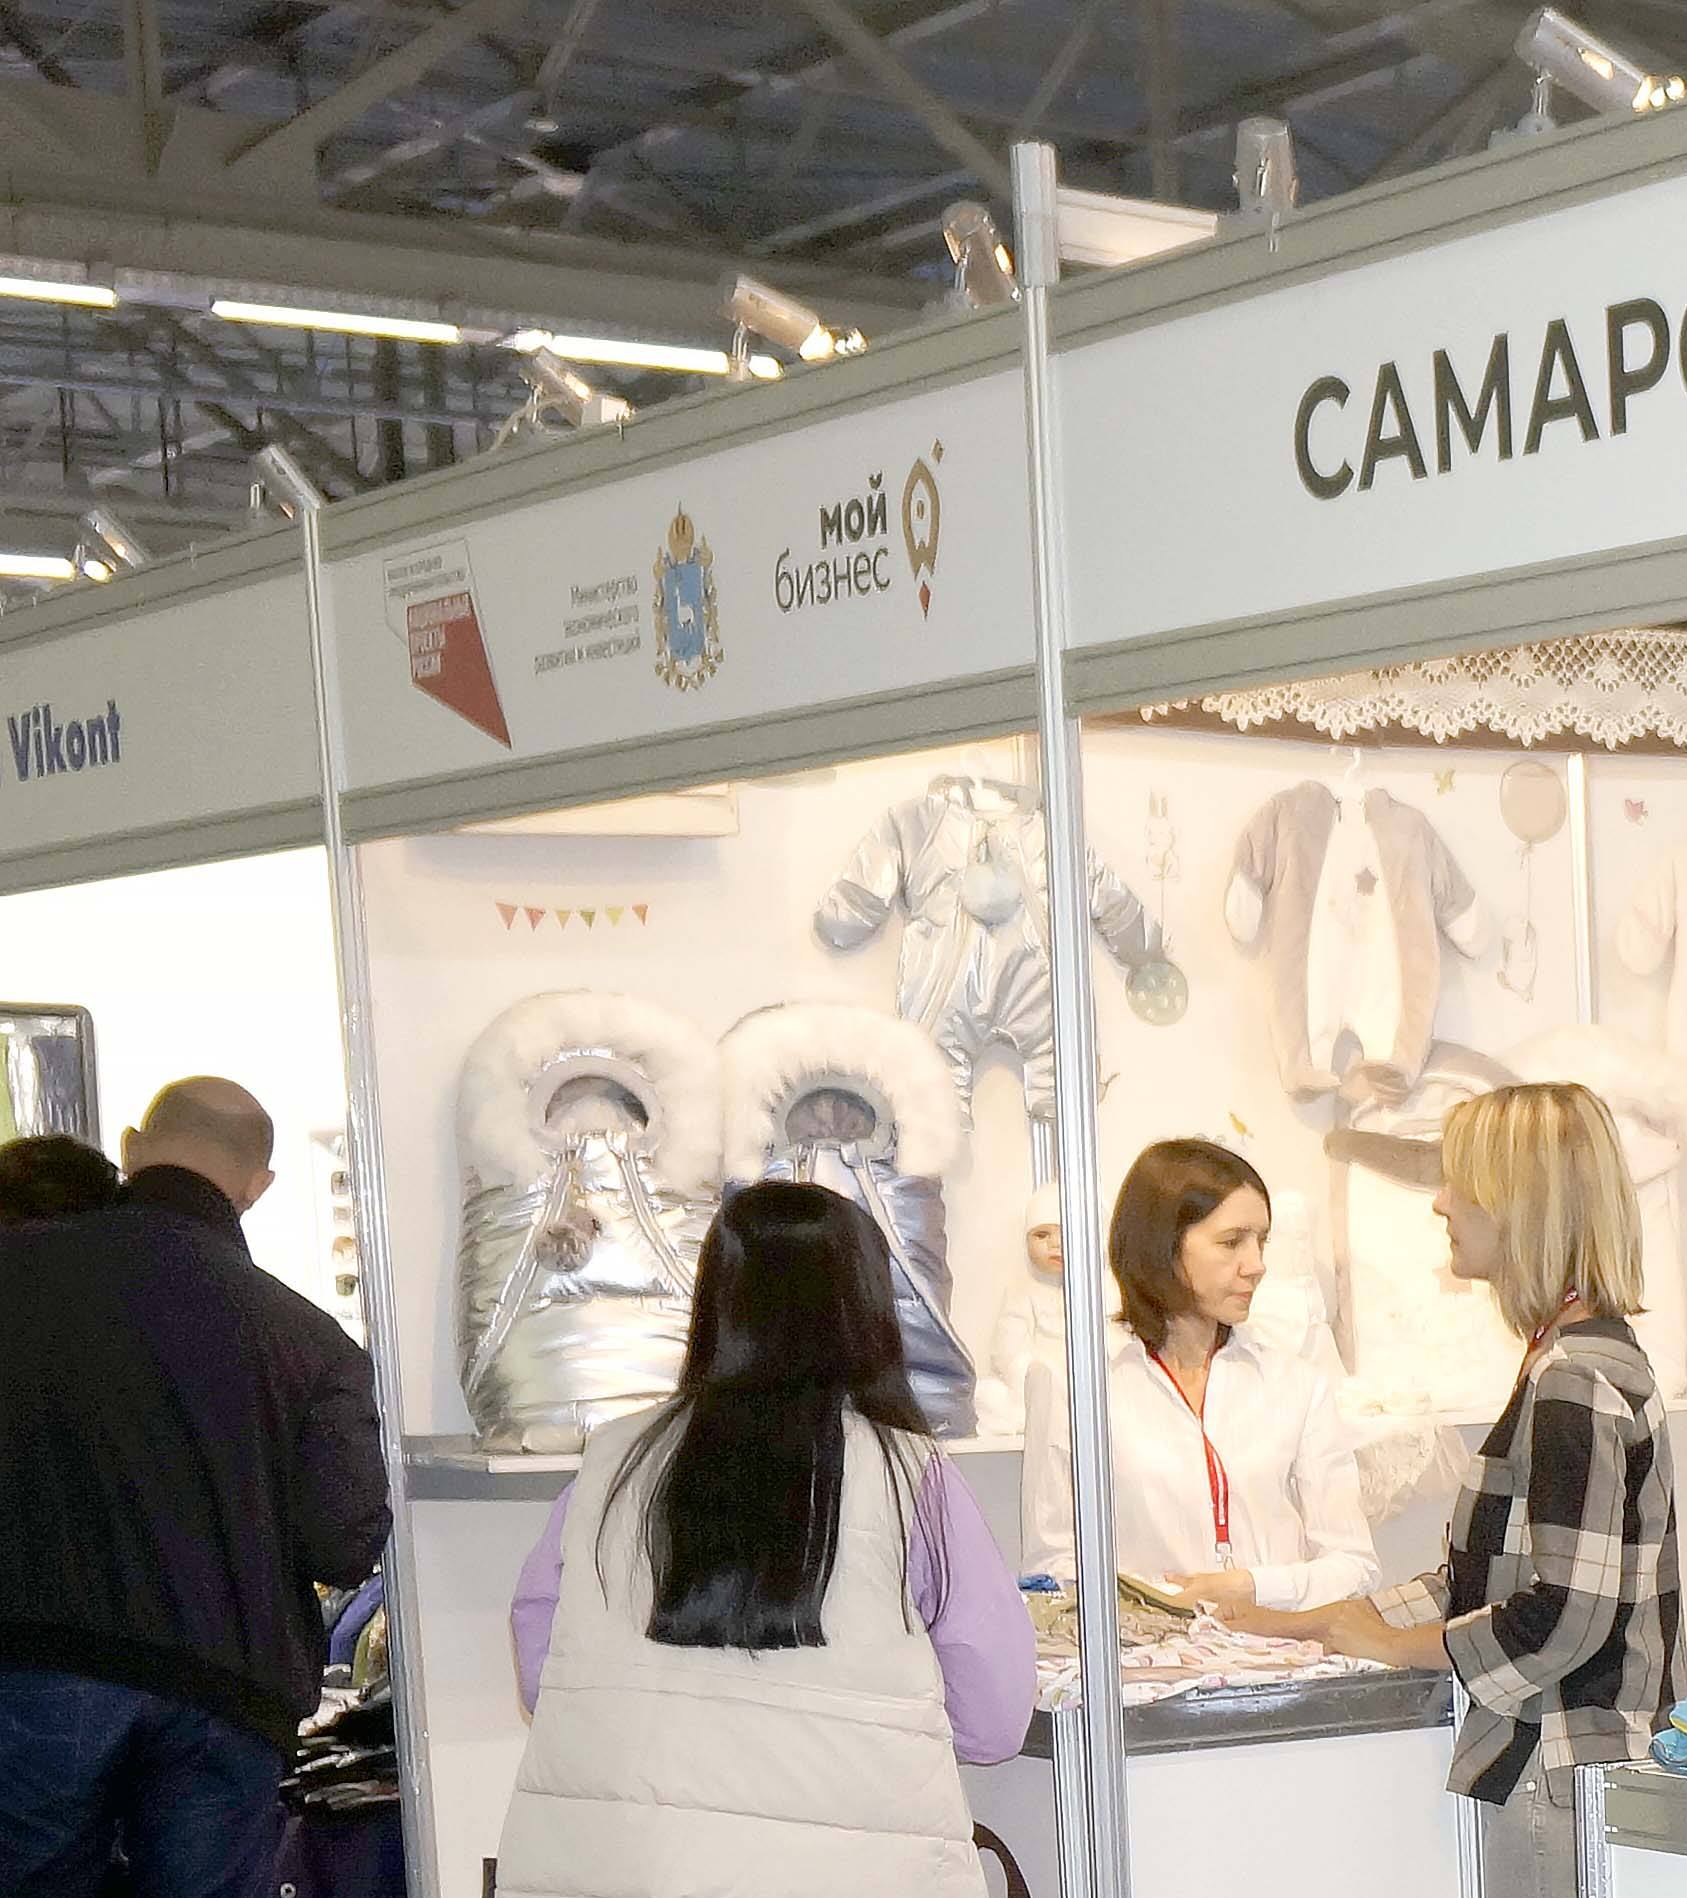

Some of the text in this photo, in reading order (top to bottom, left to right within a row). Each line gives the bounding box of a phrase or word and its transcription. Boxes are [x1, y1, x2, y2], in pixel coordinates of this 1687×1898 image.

[819, 471, 888, 549] мой
[774, 547, 890, 614] бизнес
[7, 699, 121, 782] Vikont
